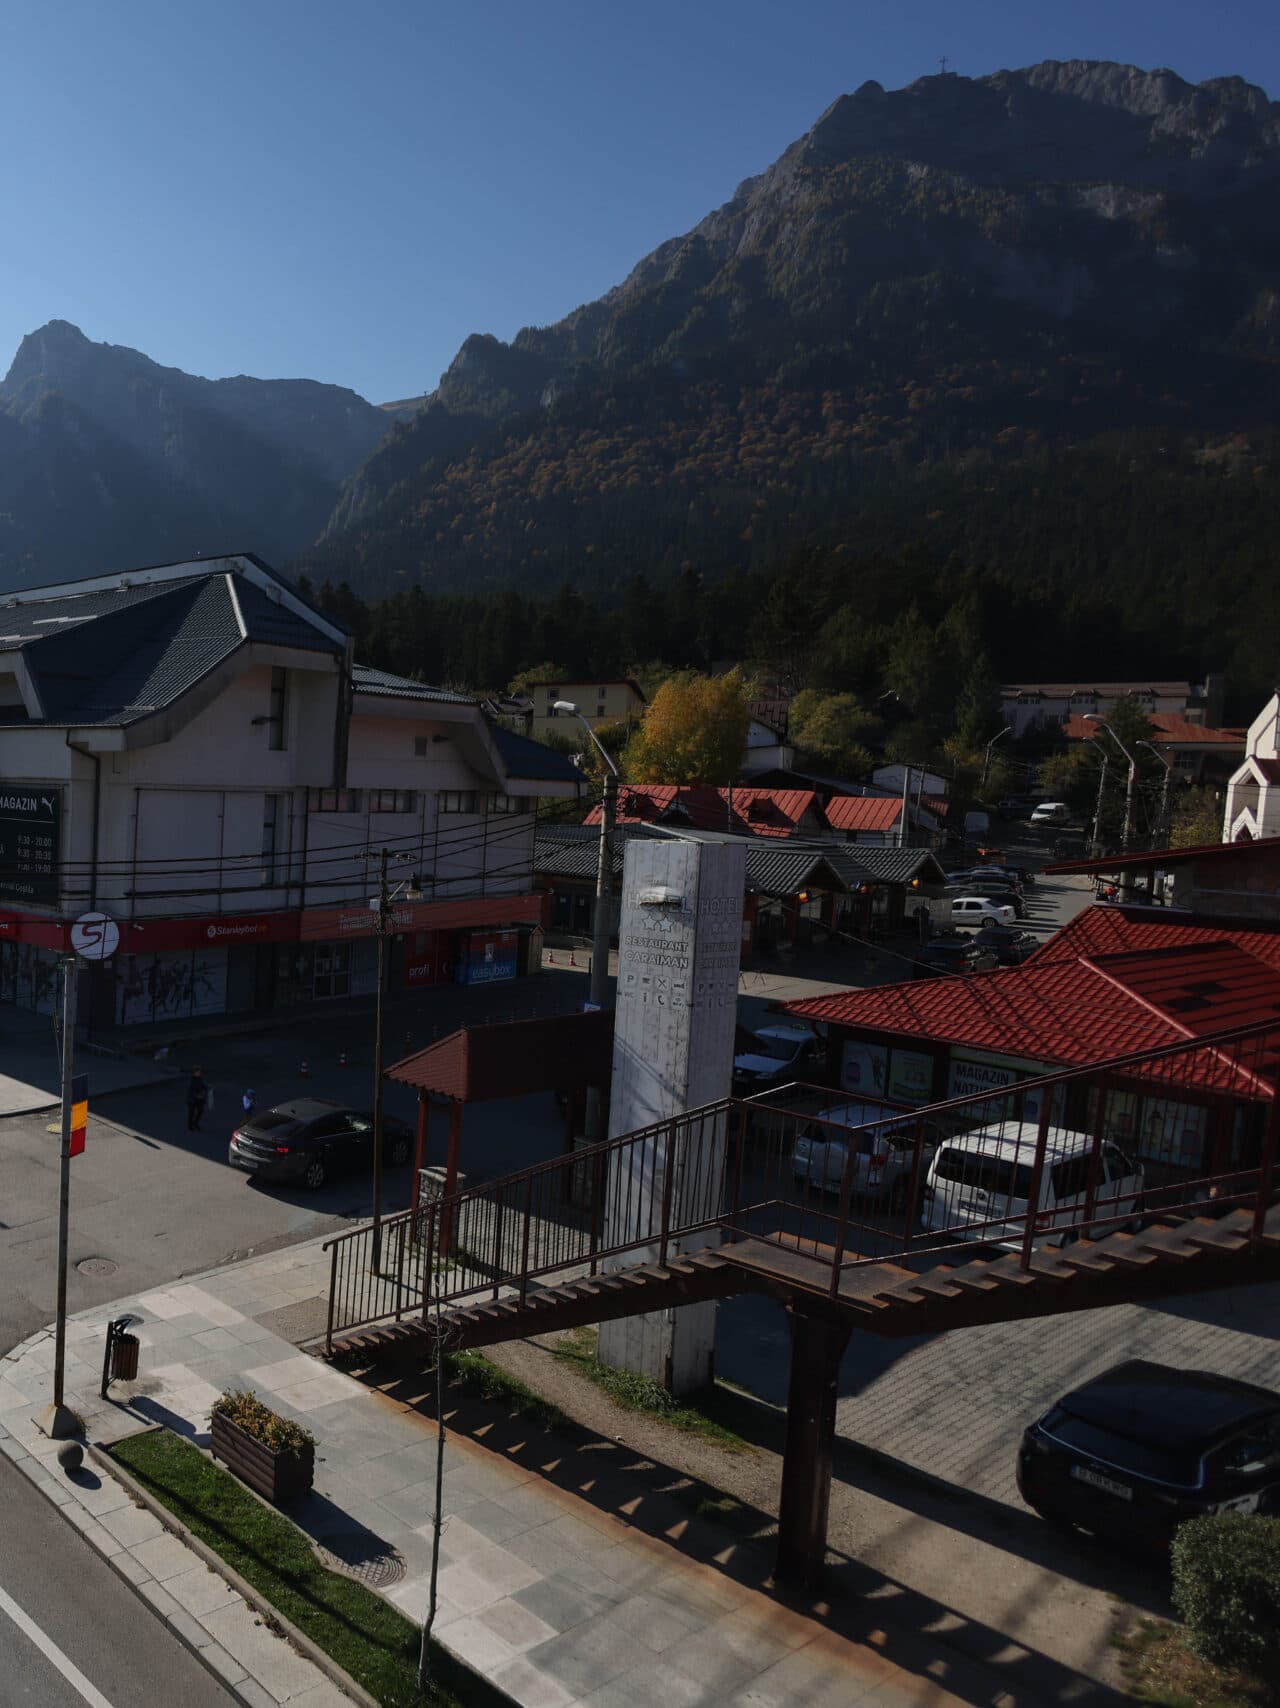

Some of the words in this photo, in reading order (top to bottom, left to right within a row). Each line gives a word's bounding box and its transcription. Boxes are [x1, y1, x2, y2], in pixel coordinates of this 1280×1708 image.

[625, 936, 689, 952] RESTAURANT
[625, 950, 689, 969] CARAIMAN
[408, 963, 430, 979] profi
[472, 962, 512, 979] easybox
[956, 1064, 1008, 1085] MAGAZIN
